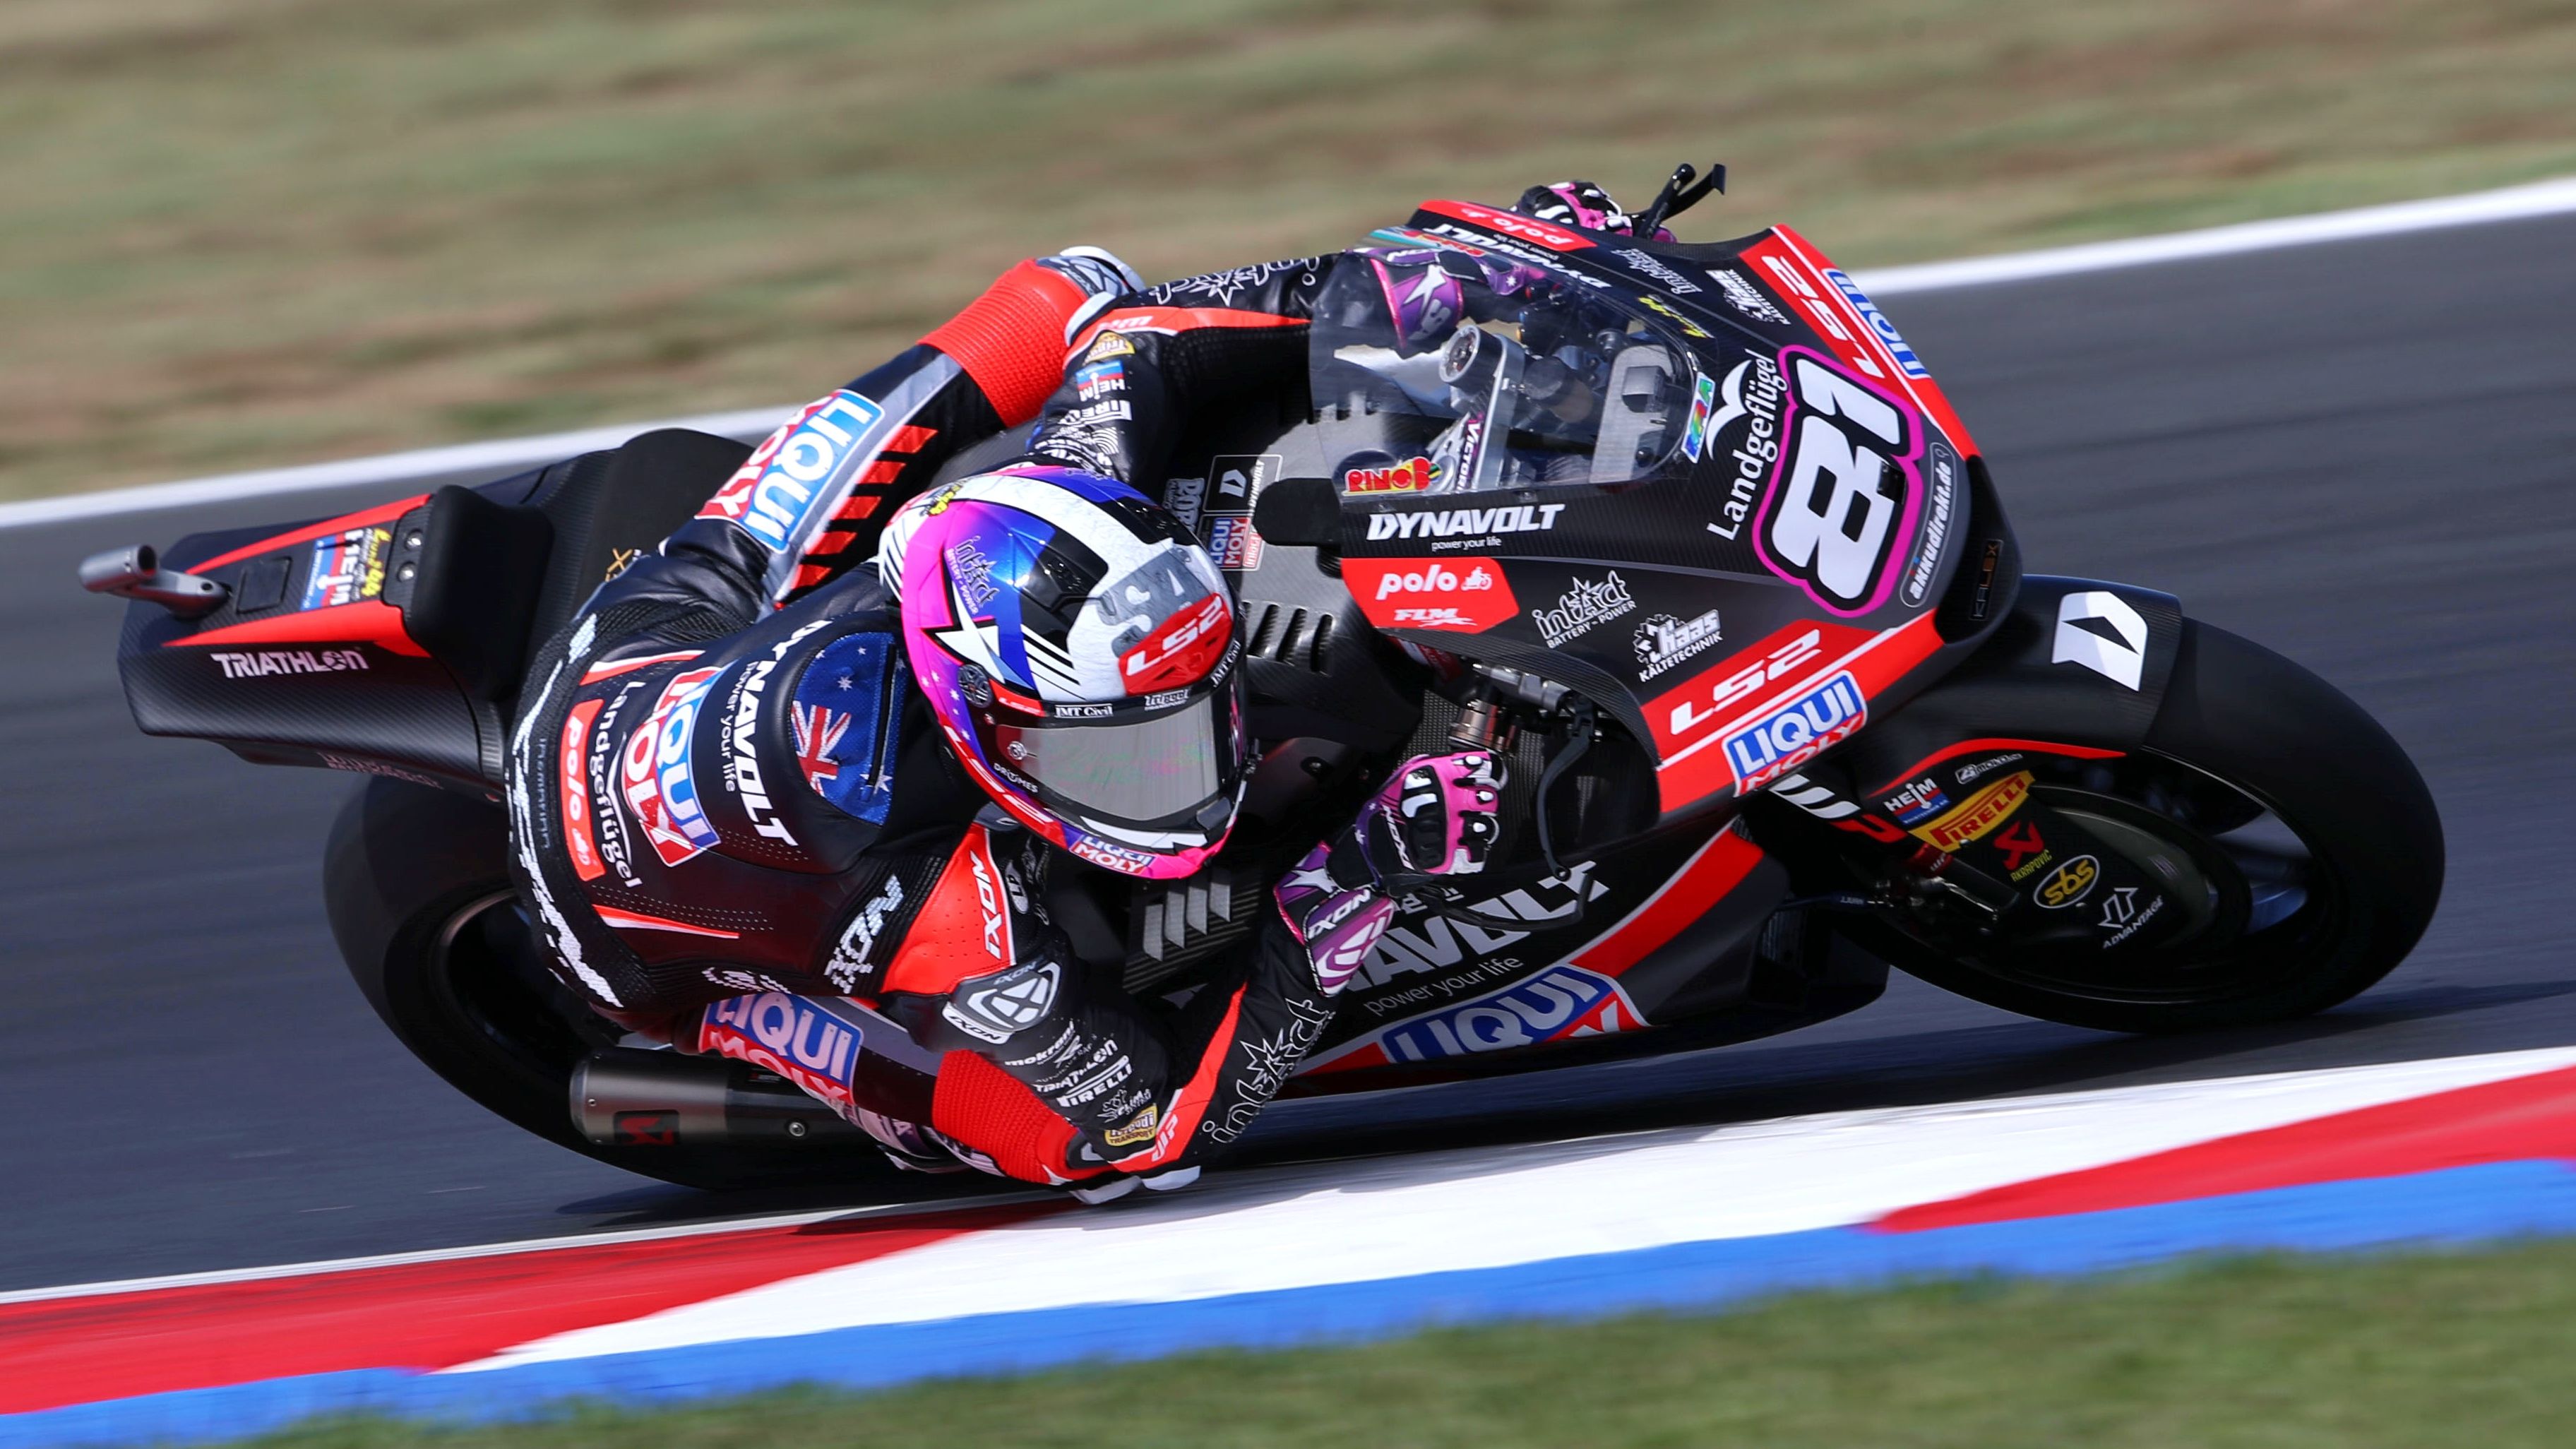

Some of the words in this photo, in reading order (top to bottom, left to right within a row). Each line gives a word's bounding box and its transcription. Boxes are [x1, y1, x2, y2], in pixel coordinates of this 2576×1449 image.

[1424, 224, 1611, 288] DYNAVOLT
[1761, 256, 1885, 378] LS2
[746, 396, 873, 543] LIQUI
[1707, 350, 1788, 540] Landgeflügel
[1771, 358, 1900, 599] 81
[1210, 520, 1231, 564] LIQUI
[1224, 520, 1246, 564] MOLY
[1367, 503, 1566, 541] DYNAVOLT
[1431, 538, 1461, 551] power
[1461, 538, 1482, 551] your
[1483, 535, 1502, 548] life
[1909, 459, 1953, 600] akkudirekt.de
[1376, 564, 1458, 600] polo
[1126, 595, 1224, 676] LS2
[1639, 631, 1723, 682] KÄLTETECHNIK
[726, 663, 756, 708] power
[1084, 704, 1112, 717] Civil
[1671, 630, 1822, 735] LS2
[720, 713, 734, 760] your
[733, 619, 833, 847] DYNAVOLT
[1731, 679, 1862, 775] LIQUI
[566, 715, 585, 821] polo
[590, 681, 645, 886] Landgeflügel
[723, 763, 737, 792] life
[1885, 778, 1938, 812] HEIM
[1929, 773, 2027, 847] PIRELLI
[1074, 847, 1145, 874] MOLY
[970, 851, 1001, 960] IXON
[1306, 888, 1371, 939] IXON
[2102, 895, 2164, 950] ADVANTAGE
[1364, 980, 1432, 1016] power
[1436, 970, 1484, 997] your
[1479, 953, 1523, 977] life
[1385, 969, 1600, 1062] LIQUI
[716, 992, 852, 1080] LIQUI
[950, 1015, 1003, 1042] IXON
[1056, 1055, 1132, 1107] PIRELLI
